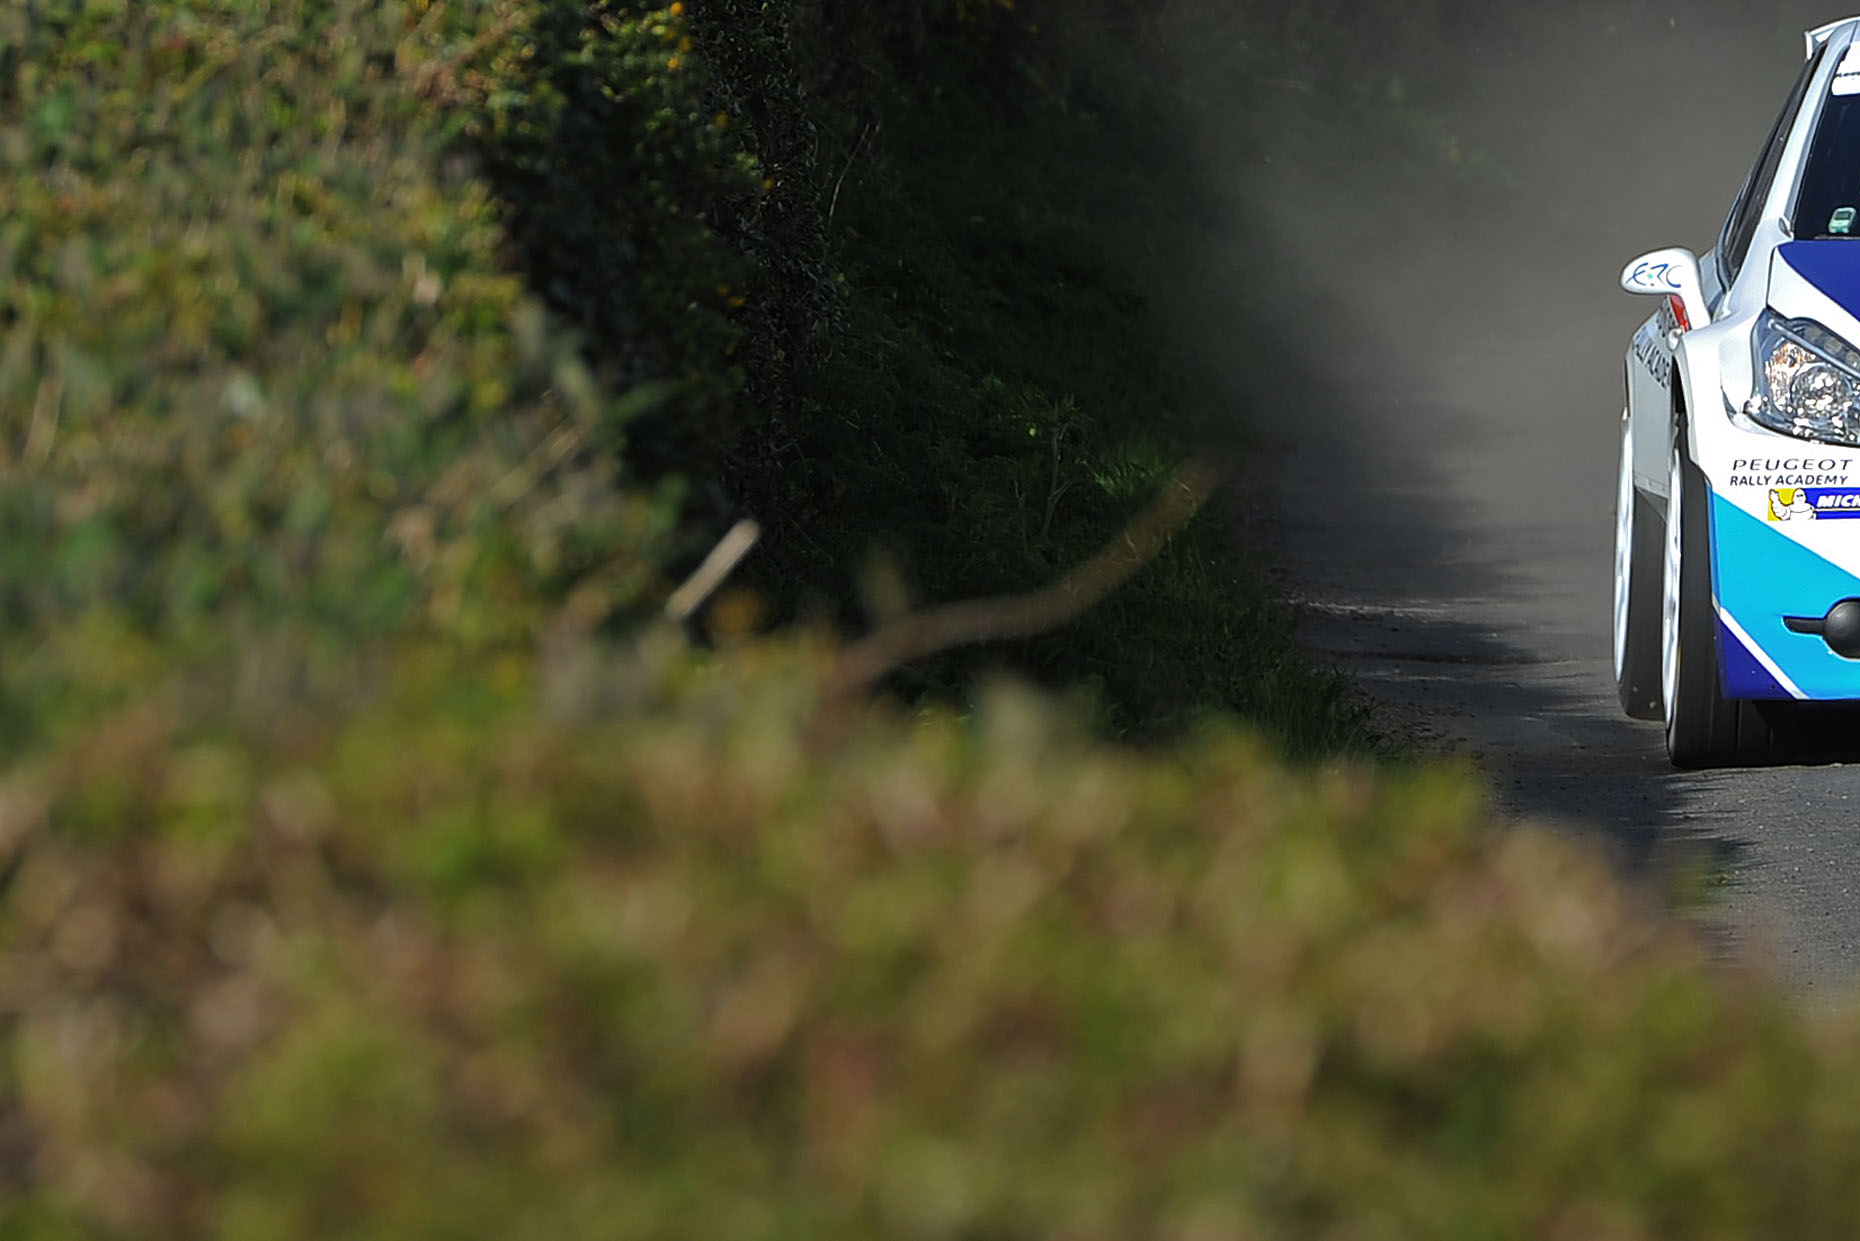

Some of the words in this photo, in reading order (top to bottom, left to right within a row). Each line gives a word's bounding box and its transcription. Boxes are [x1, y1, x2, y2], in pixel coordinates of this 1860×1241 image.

[1732, 458, 1853, 471] PEUGEOT
[1729, 475, 1772, 486] RALLY
[1775, 474, 1849, 486] ACADEMY
